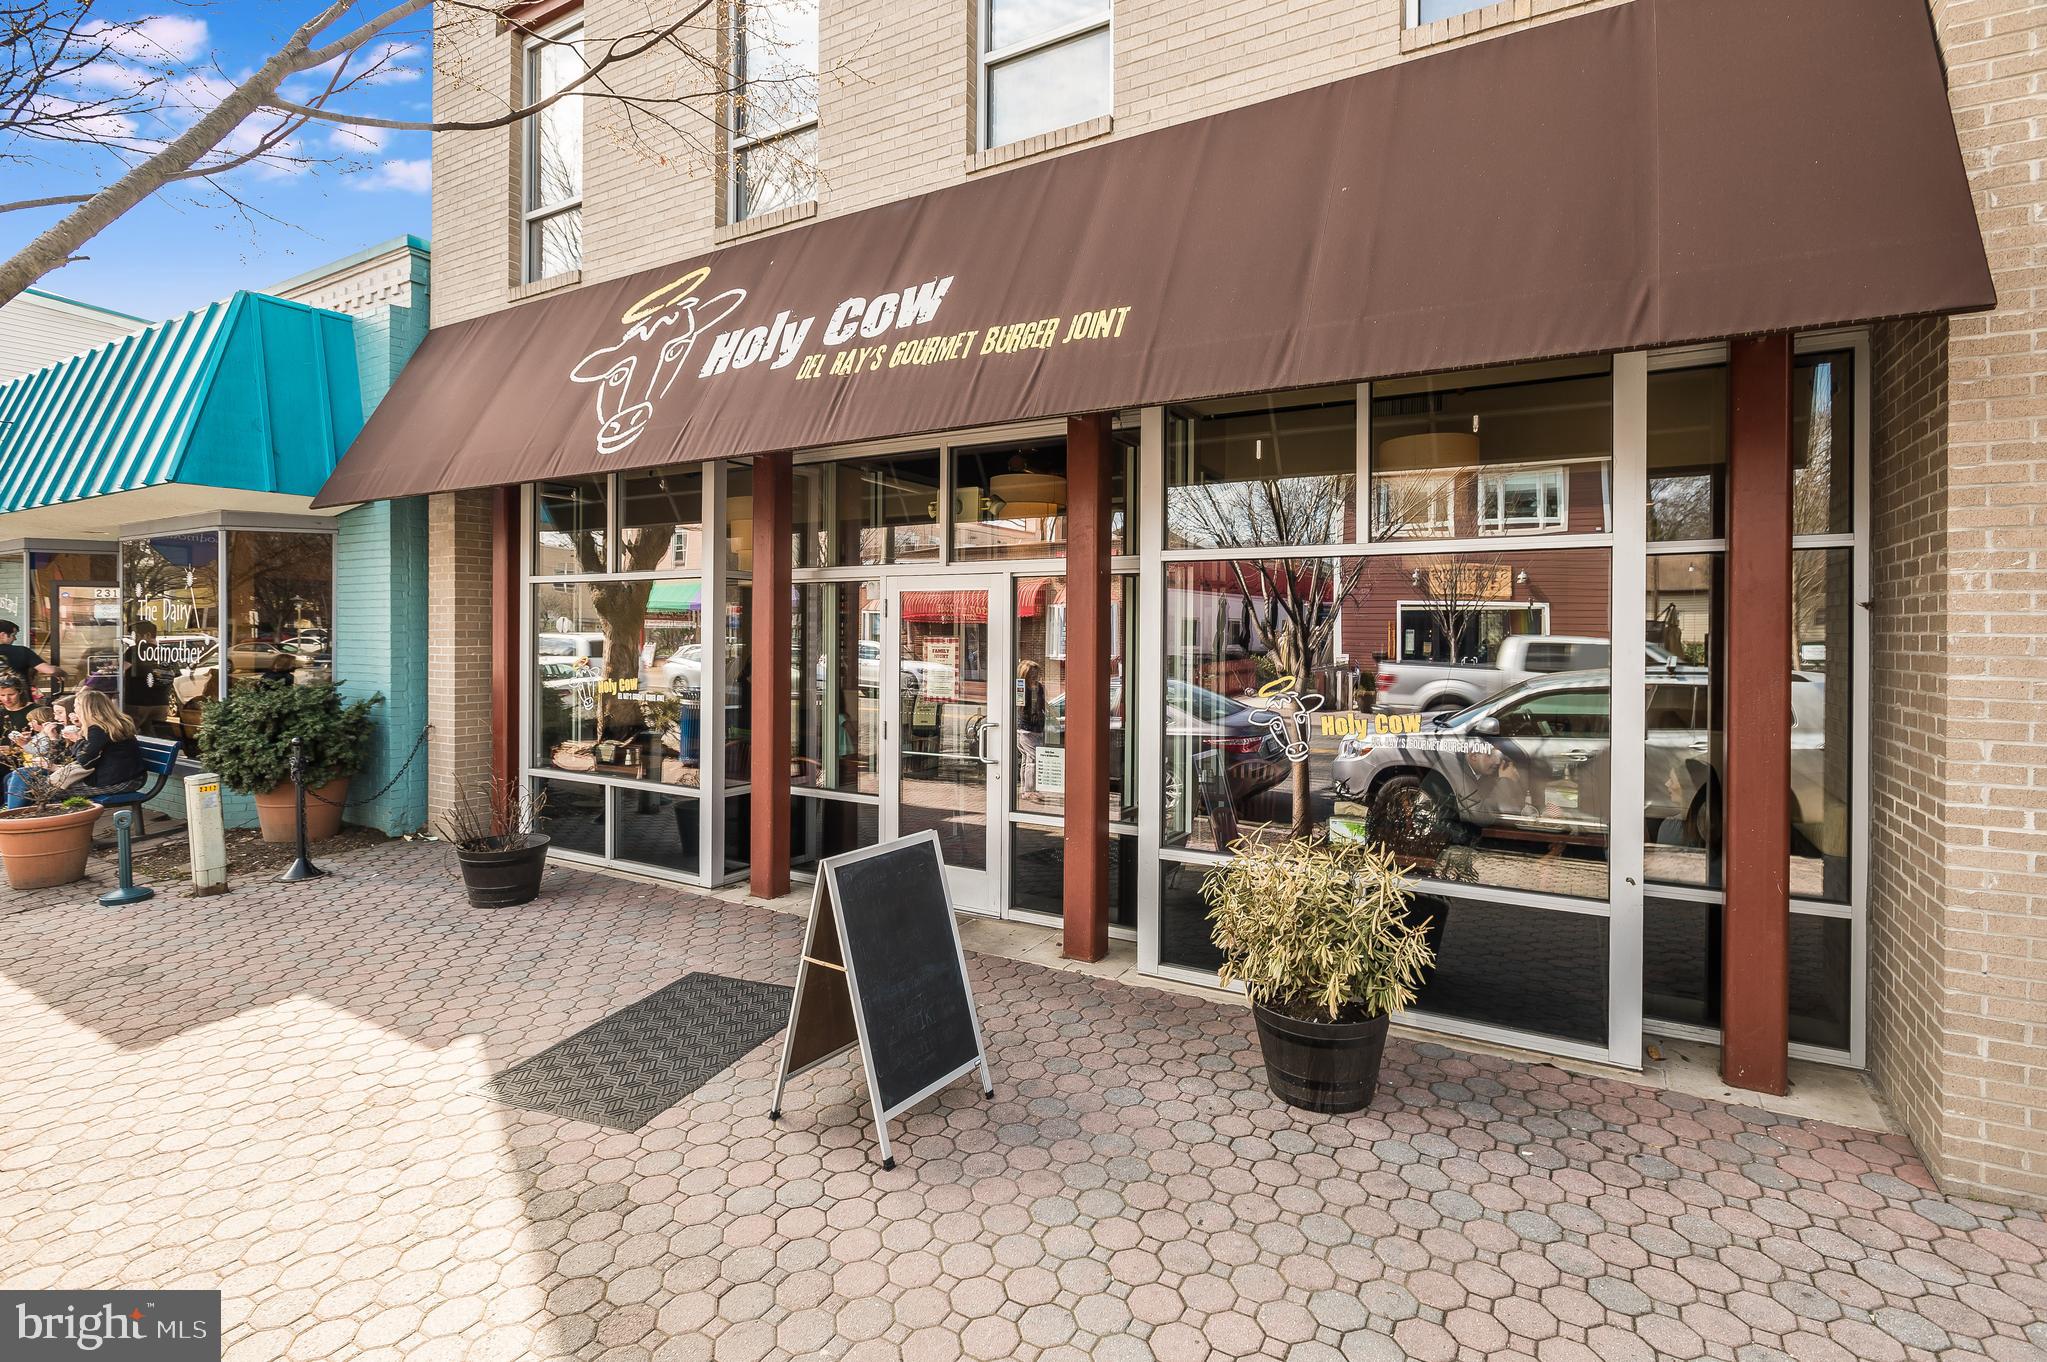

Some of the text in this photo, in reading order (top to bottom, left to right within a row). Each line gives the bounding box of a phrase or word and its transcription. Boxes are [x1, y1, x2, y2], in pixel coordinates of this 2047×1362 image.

[698, 309, 816, 379] Holy
[795, 306, 1132, 381] DEL RAY'S GOURMET BURGER JOINT
[138, 593, 193, 629] The Dairy
[137, 638, 203, 665] Godmother
[598, 678, 618, 695] Holy
[1321, 713, 1368, 740] Holy
[1408, 737, 1441, 751] GOURMET
[1442, 739, 1469, 753] BURGER
[1471, 741, 1492, 755] JOINT
